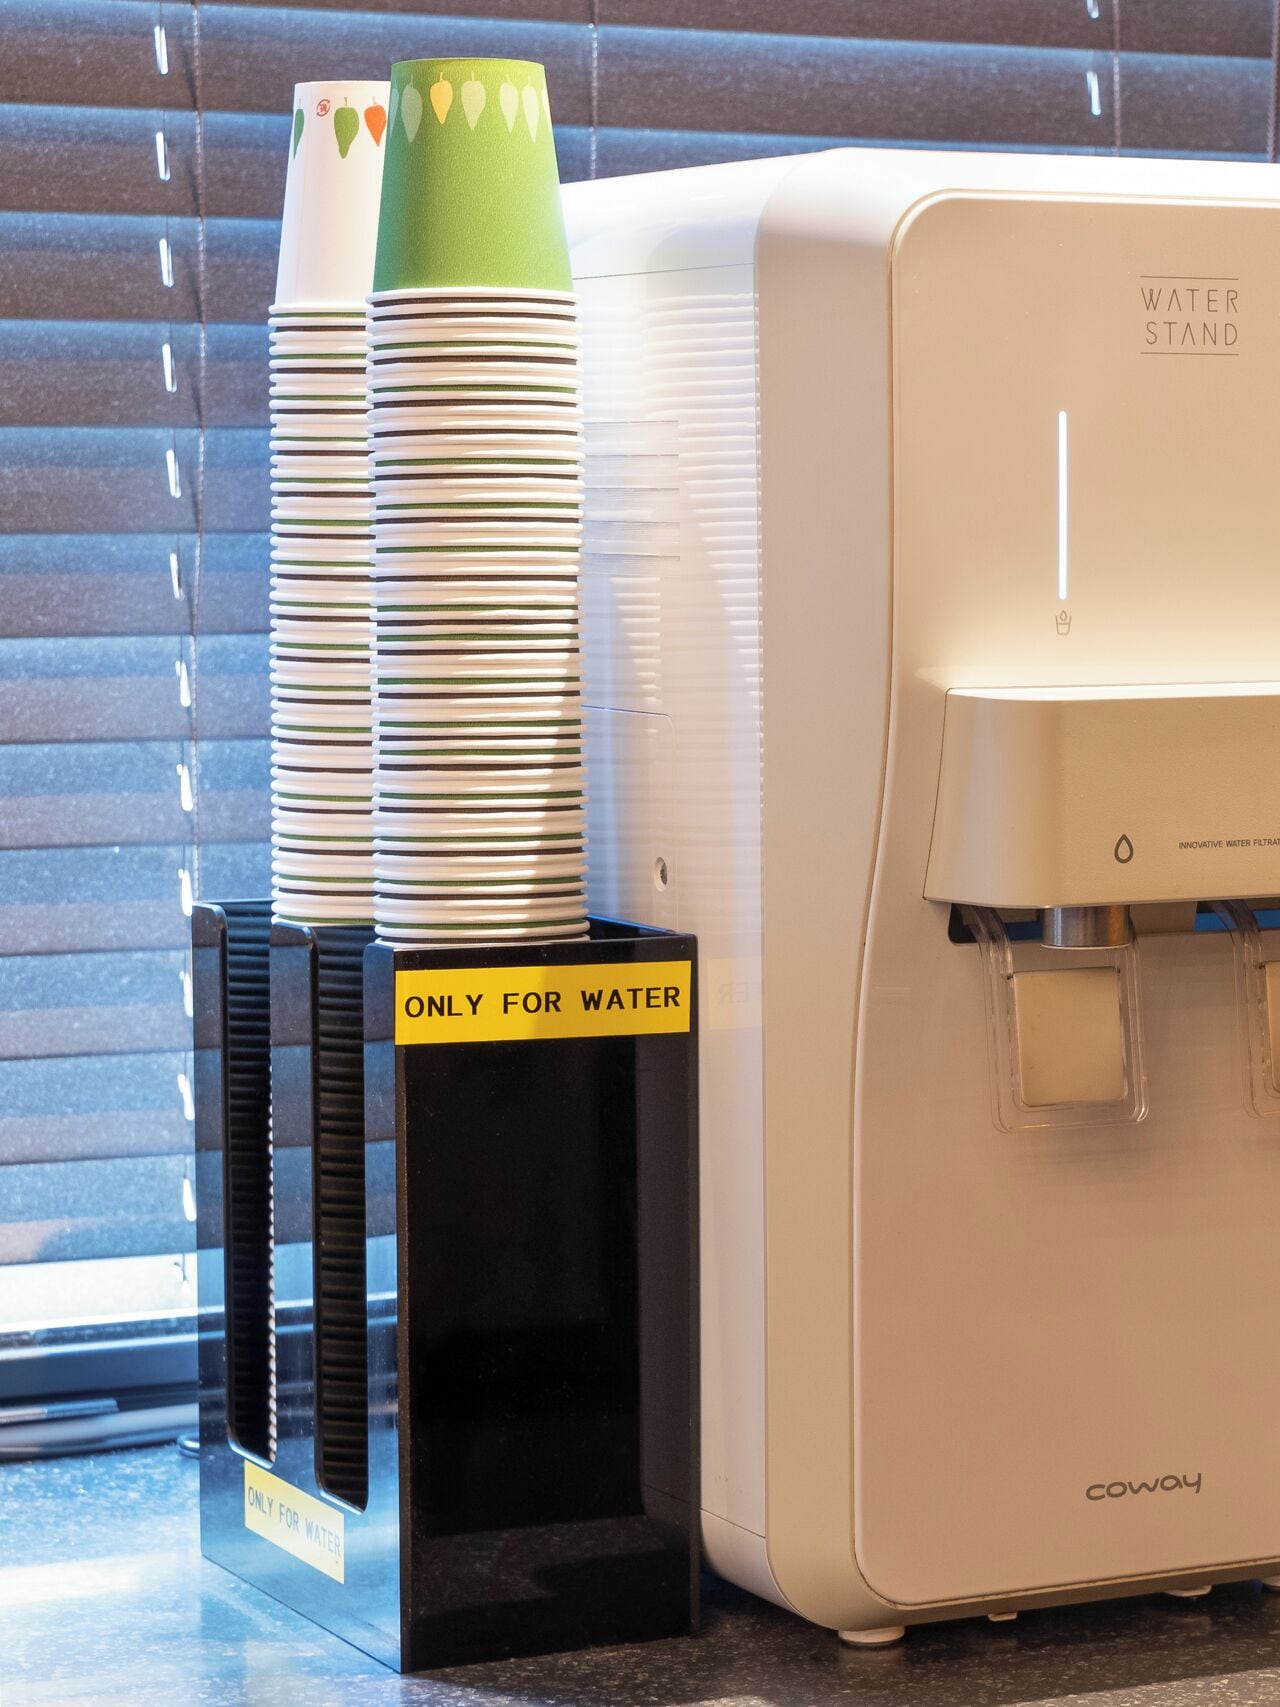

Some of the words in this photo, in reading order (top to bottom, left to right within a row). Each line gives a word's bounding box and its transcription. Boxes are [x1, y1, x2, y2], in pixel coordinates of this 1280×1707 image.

[1140, 287, 1239, 313] WATER
[1145, 320, 1238, 346] STAND
[1178, 839, 1223, 850] INNOVATIVE
[1225, 839, 1251, 848] WATER
[404, 993, 483, 1018] ONLY
[502, 990, 562, 1015] FOR
[580, 985, 681, 1012] WATER
[1085, 1472, 1202, 1501] coway
[248, 1486, 274, 1518] ONLY
[279, 1503, 300, 1534] FOR
[304, 1518, 341, 1557] WATER
